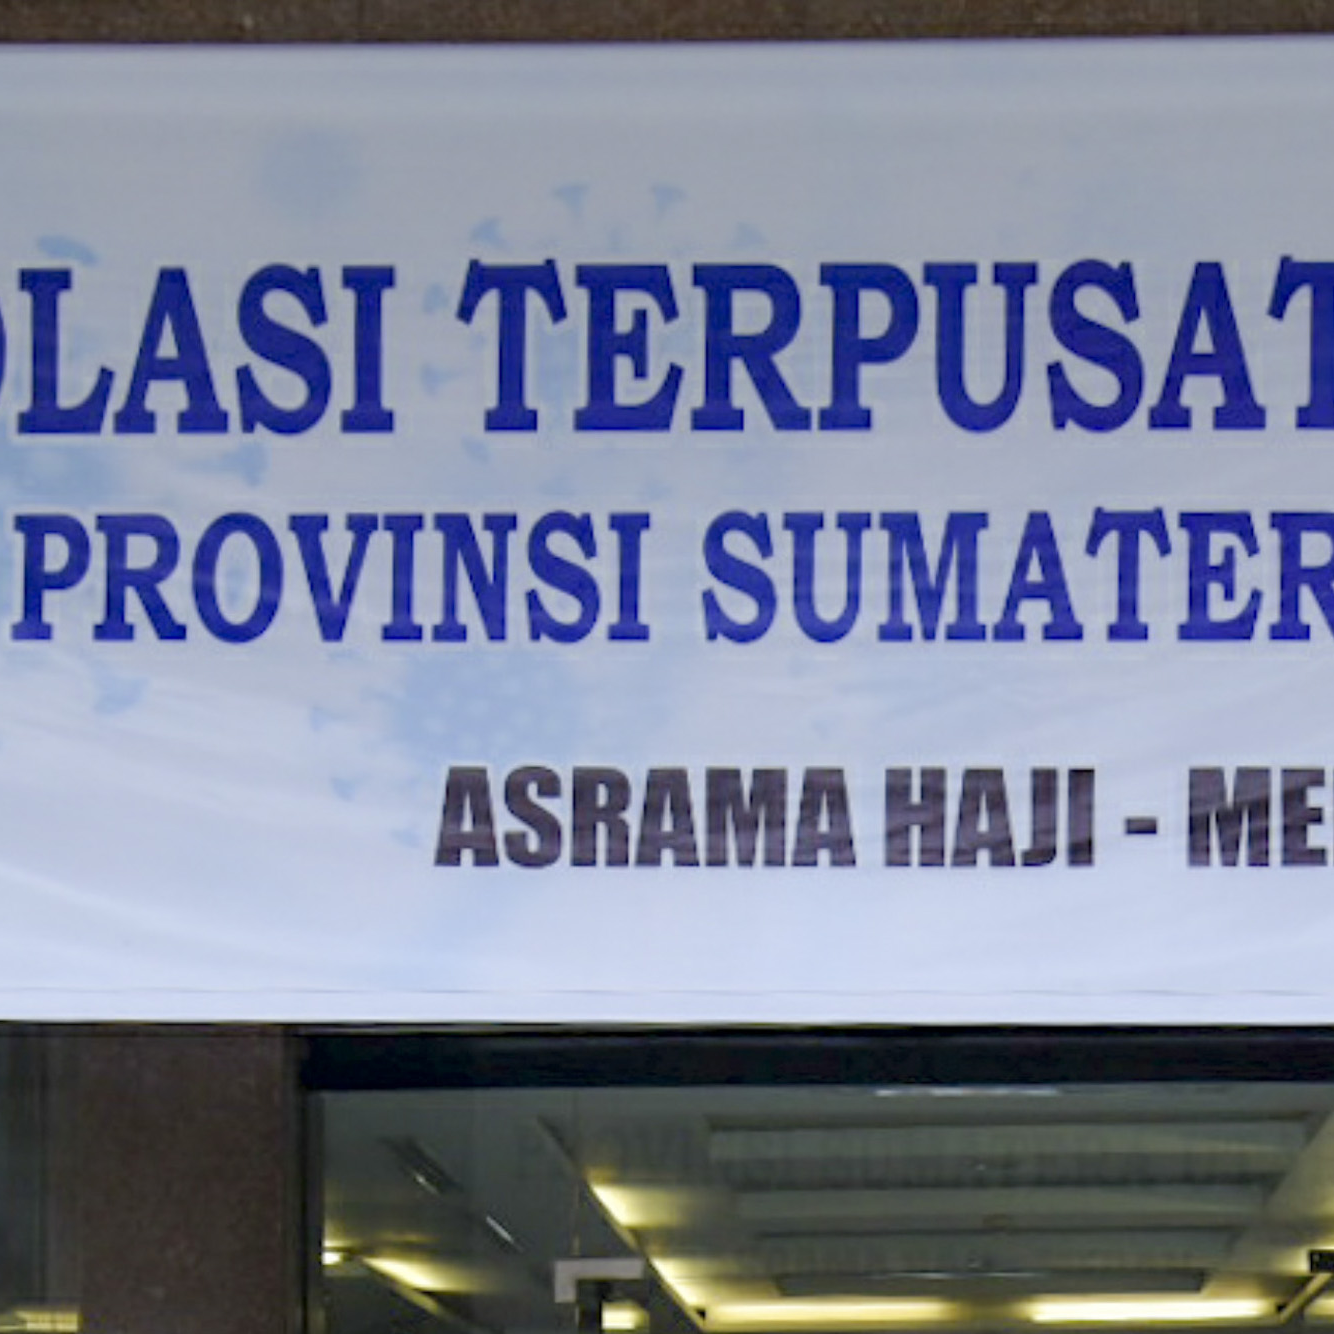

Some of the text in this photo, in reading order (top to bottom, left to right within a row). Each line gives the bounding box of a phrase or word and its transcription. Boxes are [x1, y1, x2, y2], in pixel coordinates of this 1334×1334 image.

[11, 512, 651, 643] PROVINSI
[433, 766, 857, 868] ASRAMA
[882, 767, 1096, 867] HAJI
